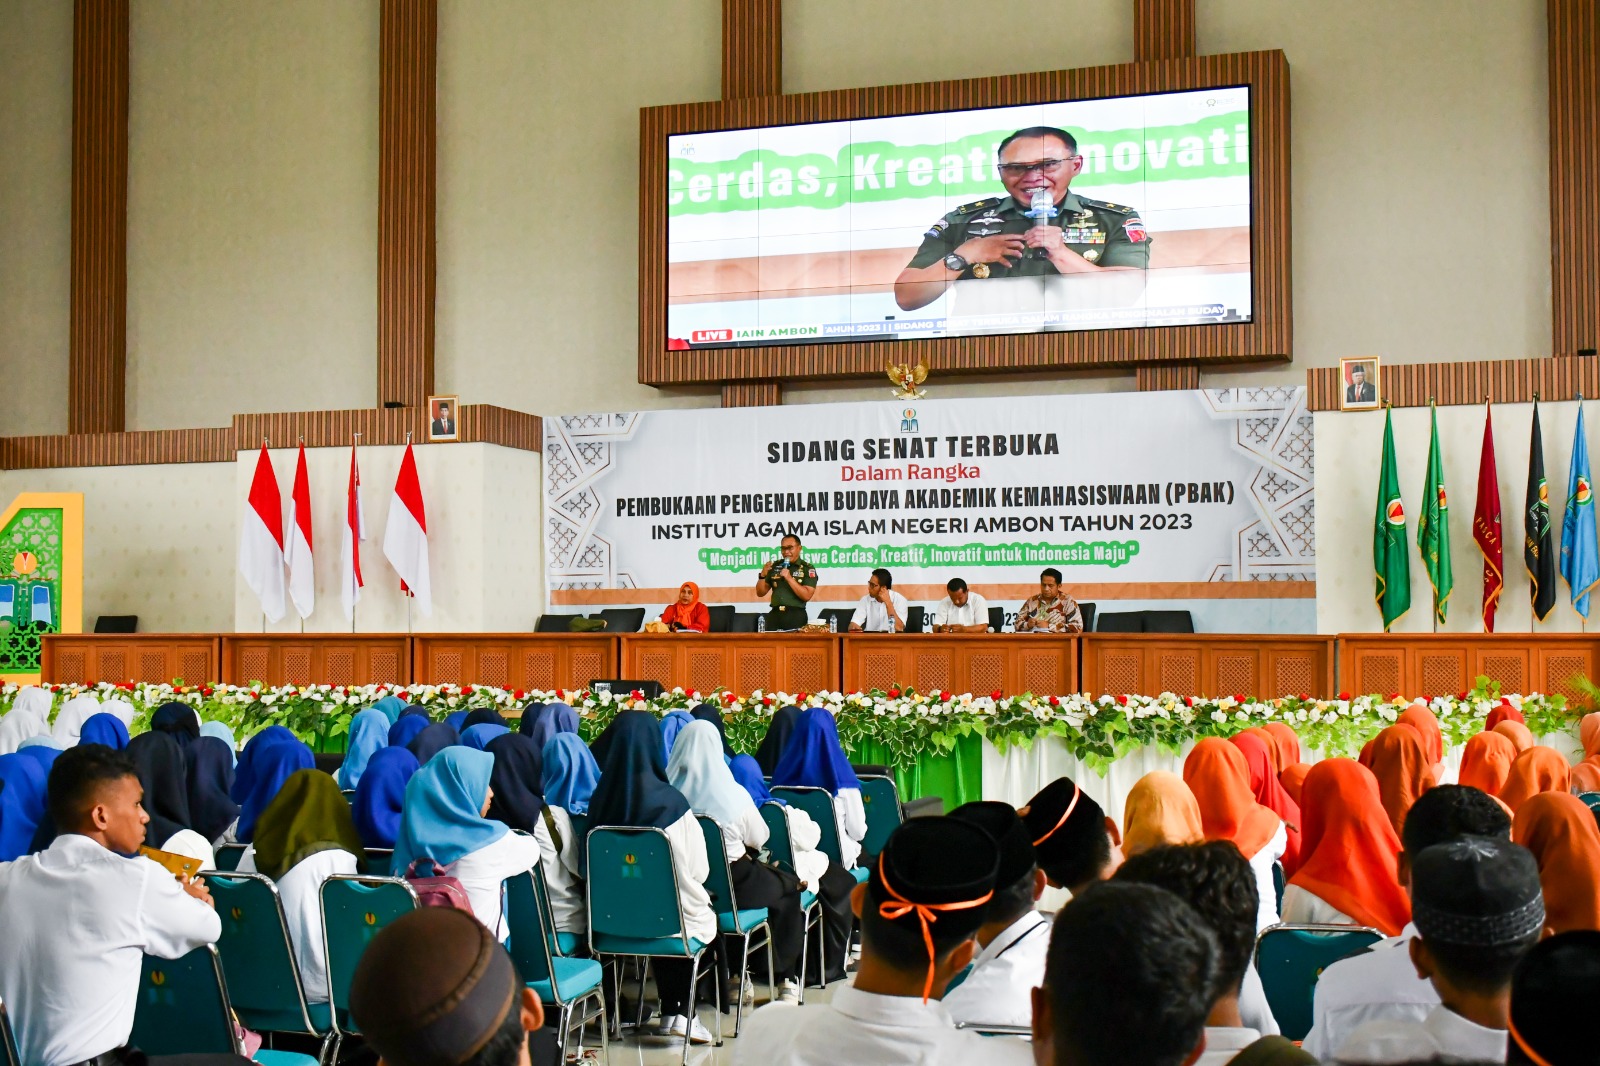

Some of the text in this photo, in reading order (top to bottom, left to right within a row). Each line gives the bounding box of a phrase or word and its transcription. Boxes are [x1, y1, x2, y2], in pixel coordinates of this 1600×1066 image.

[669, 123, 1248, 206] Cerdas, Kreati novati
[697, 331, 728, 341] LIVE
[736, 327, 818, 338] IAIN AMBON
[825, 325, 855, 334] AHUN
[856, 324, 881, 332] 2023
[894, 321, 934, 331] SIDANG
[767, 433, 1060, 463] SIDANG SENAT TERBUKA
[841, 462, 980, 483] Dalam Rangka
[616, 480, 1235, 517] PEMBUKAAN PENGENALAN BUDAYA AKADEMIK KEMAHASISWAAN (PBAK)
[652, 513, 1193, 540] INSTITUT AGAMA ISLAM NEGERI AMBON TAHUN 2023
[710, 551, 757, 568] Menjadi
[831, 548, 878, 564] Cerdas,
[880, 547, 928, 564] Kreatif,
[931, 545, 982, 563] Inovatif
[984, 547, 1023, 562] untuk
[1025, 545, 1091, 562] Indonesia
[1093, 545, 1126, 564] Maju
